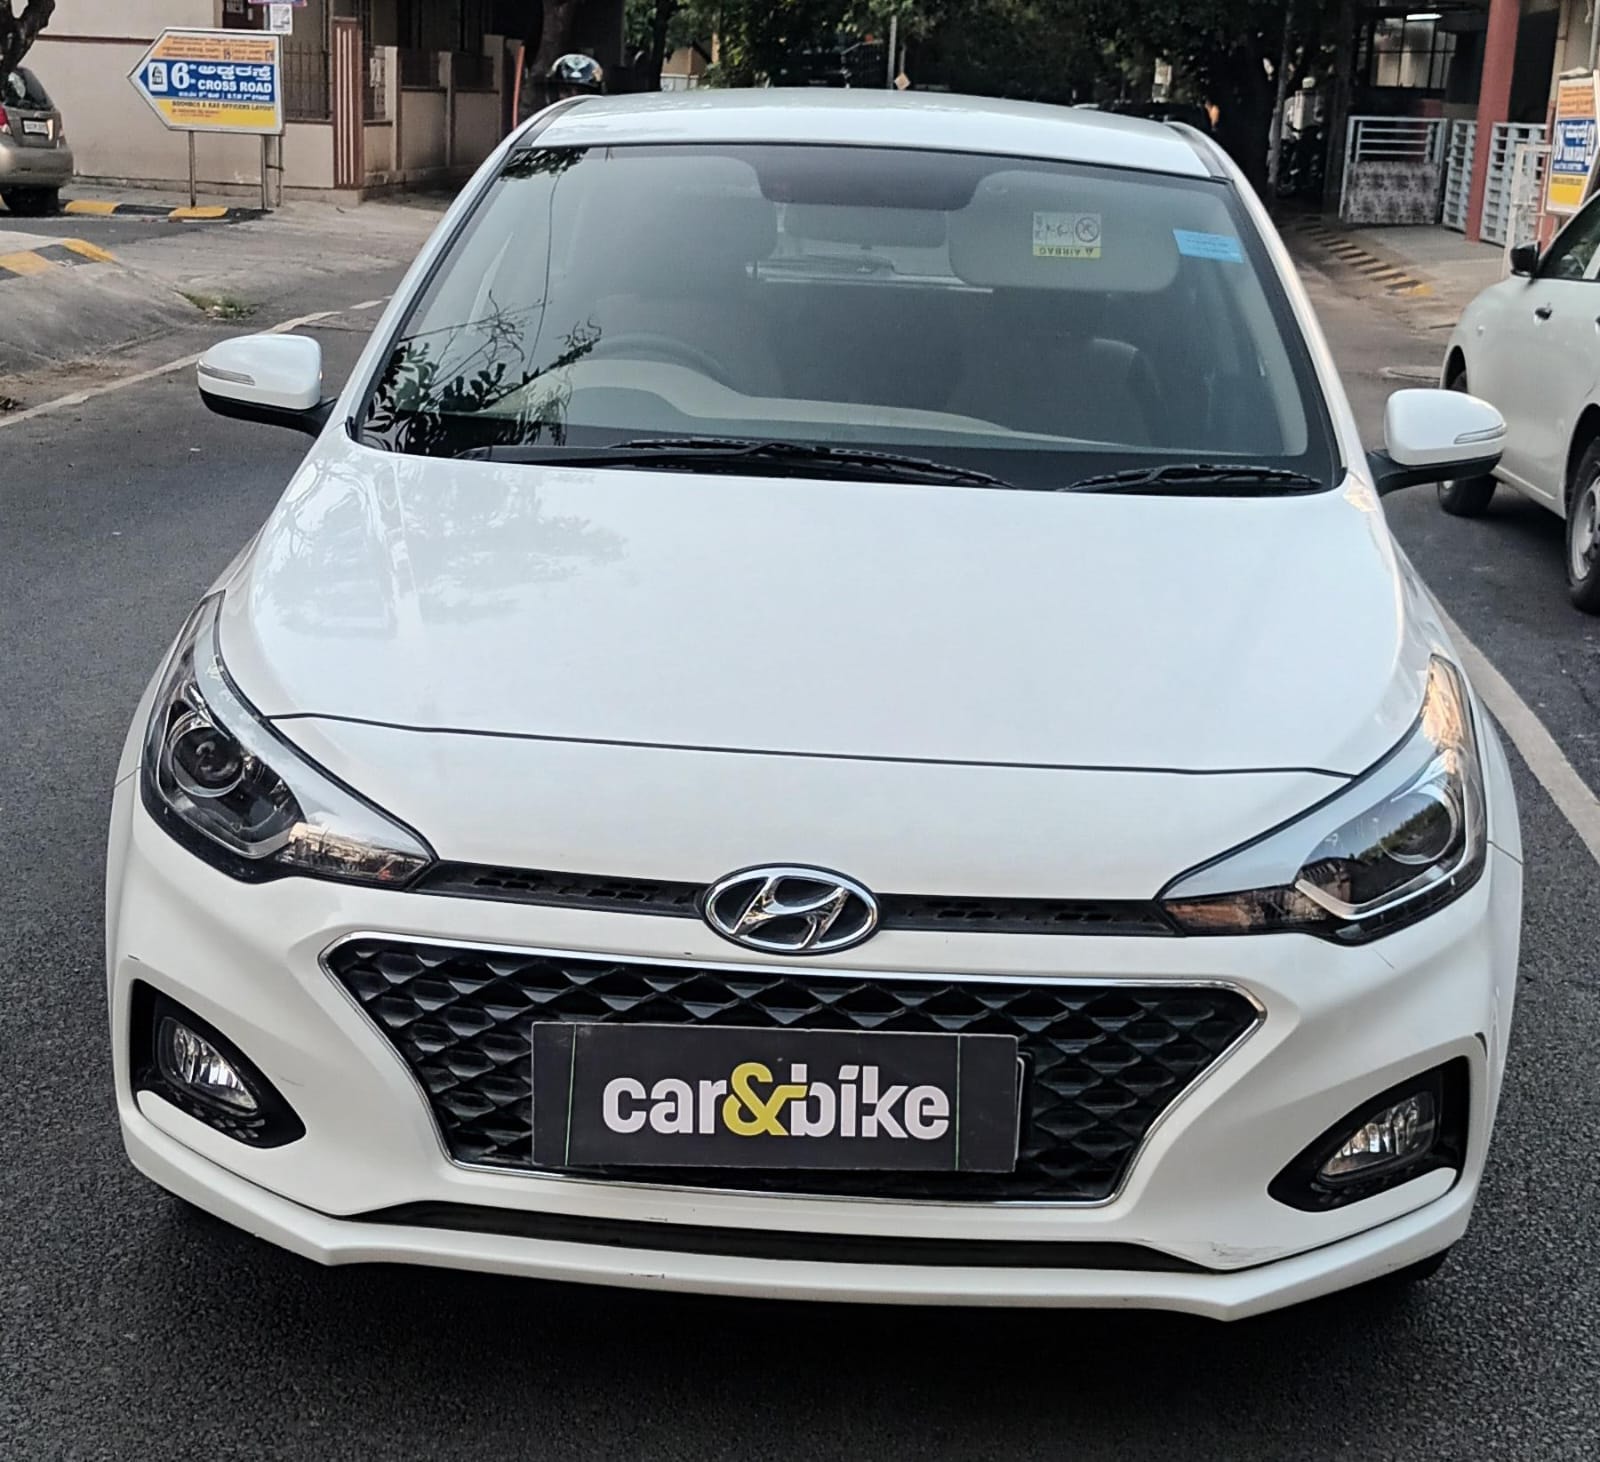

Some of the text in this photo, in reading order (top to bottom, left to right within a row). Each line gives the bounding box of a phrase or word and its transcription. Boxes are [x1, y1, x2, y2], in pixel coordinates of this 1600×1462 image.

[198, 80, 272, 93] CROSS ROAD
[1039, 247, 1081, 257] AIRBAG
[602, 1062, 951, 1141] car&bike
